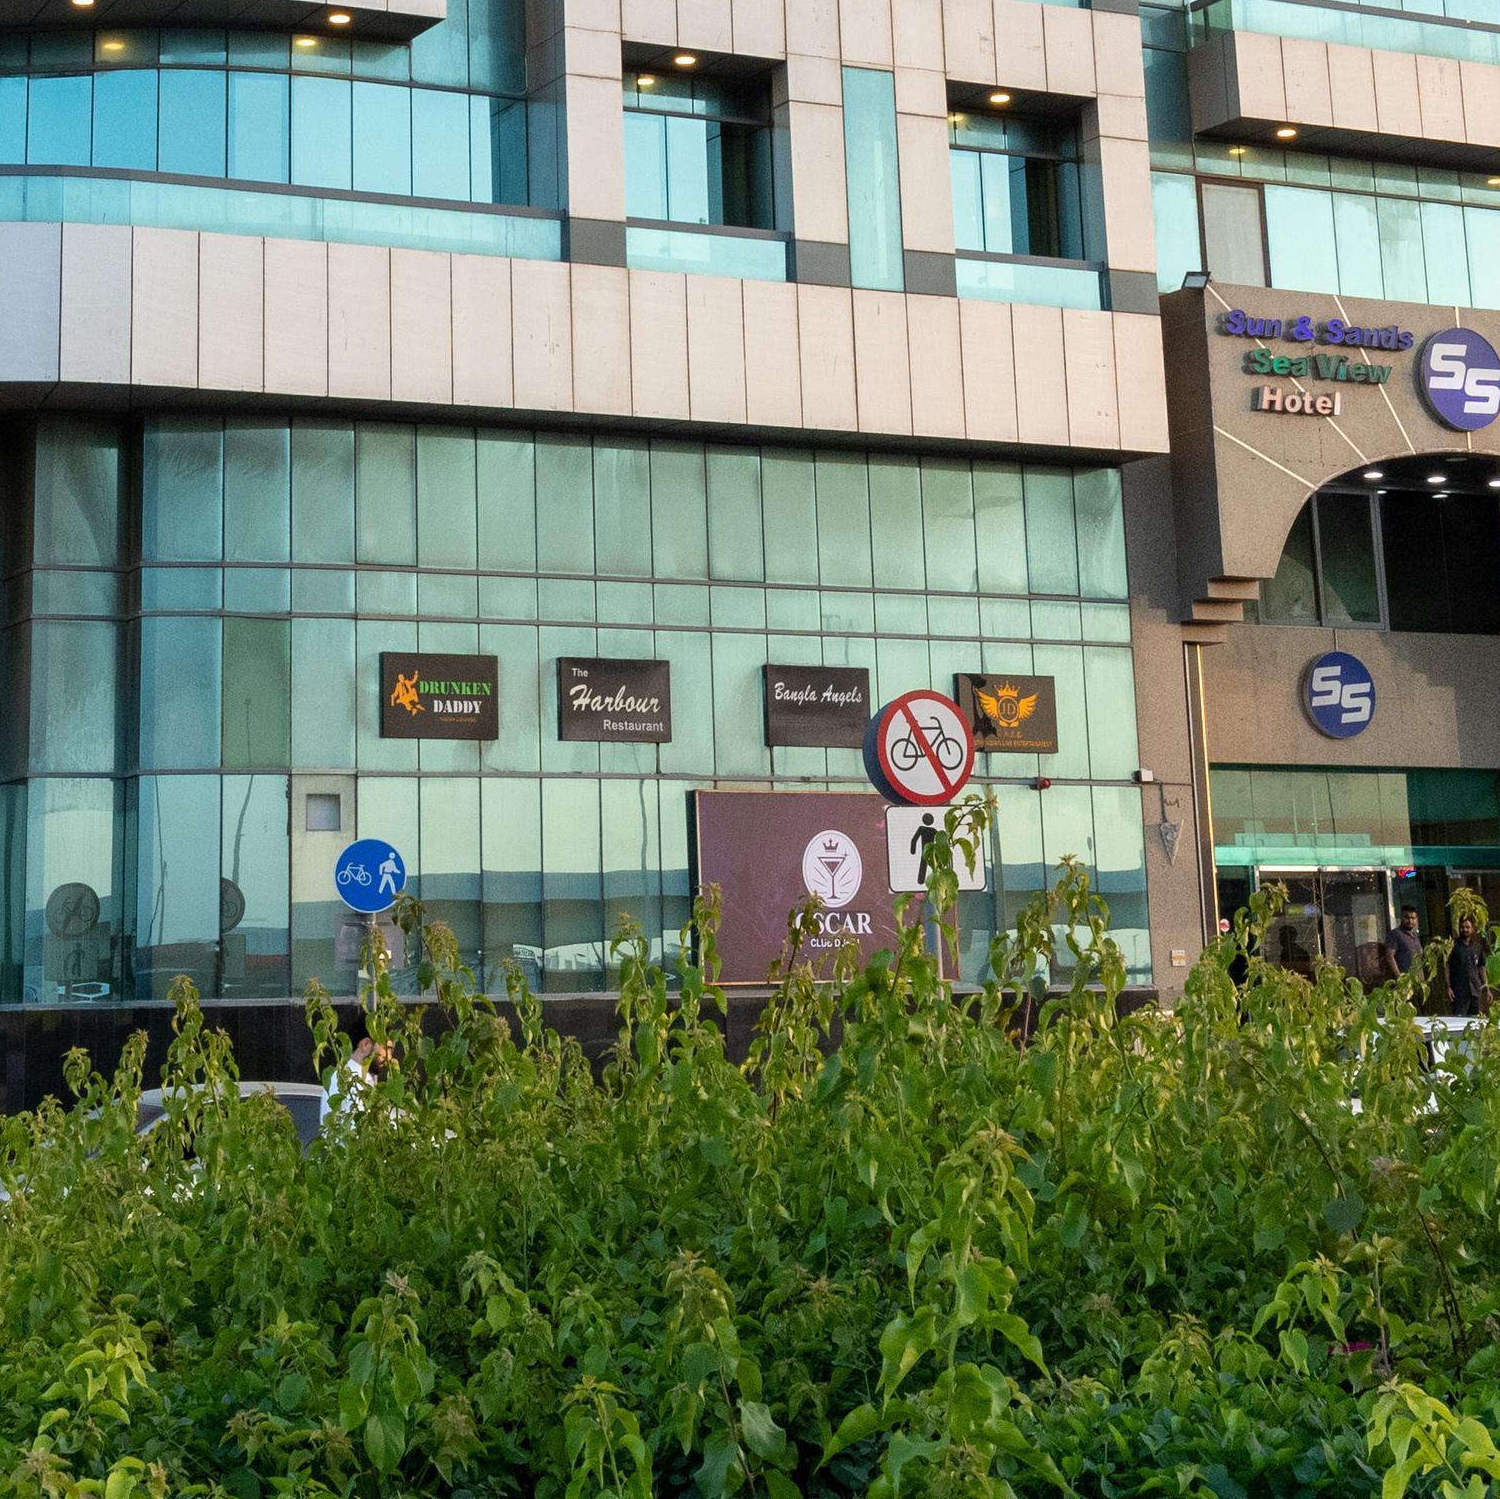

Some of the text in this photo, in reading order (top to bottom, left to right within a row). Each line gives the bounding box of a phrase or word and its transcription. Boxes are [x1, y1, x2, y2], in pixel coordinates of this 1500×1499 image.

[1226, 310, 1414, 350] Sun & Sands
[1252, 348, 1393, 384] Sea View
[1261, 385, 1342, 416] Hotel
[572, 668, 589, 678] The
[419, 680, 492, 696] DRUNKEN
[569, 684, 661, 714] Harbour
[774, 682, 863, 707] Bangla Angels
[1311, 665, 1372, 724] SS
[433, 699, 482, 714] DADDY
[603, 719, 664, 733] Restaurant
